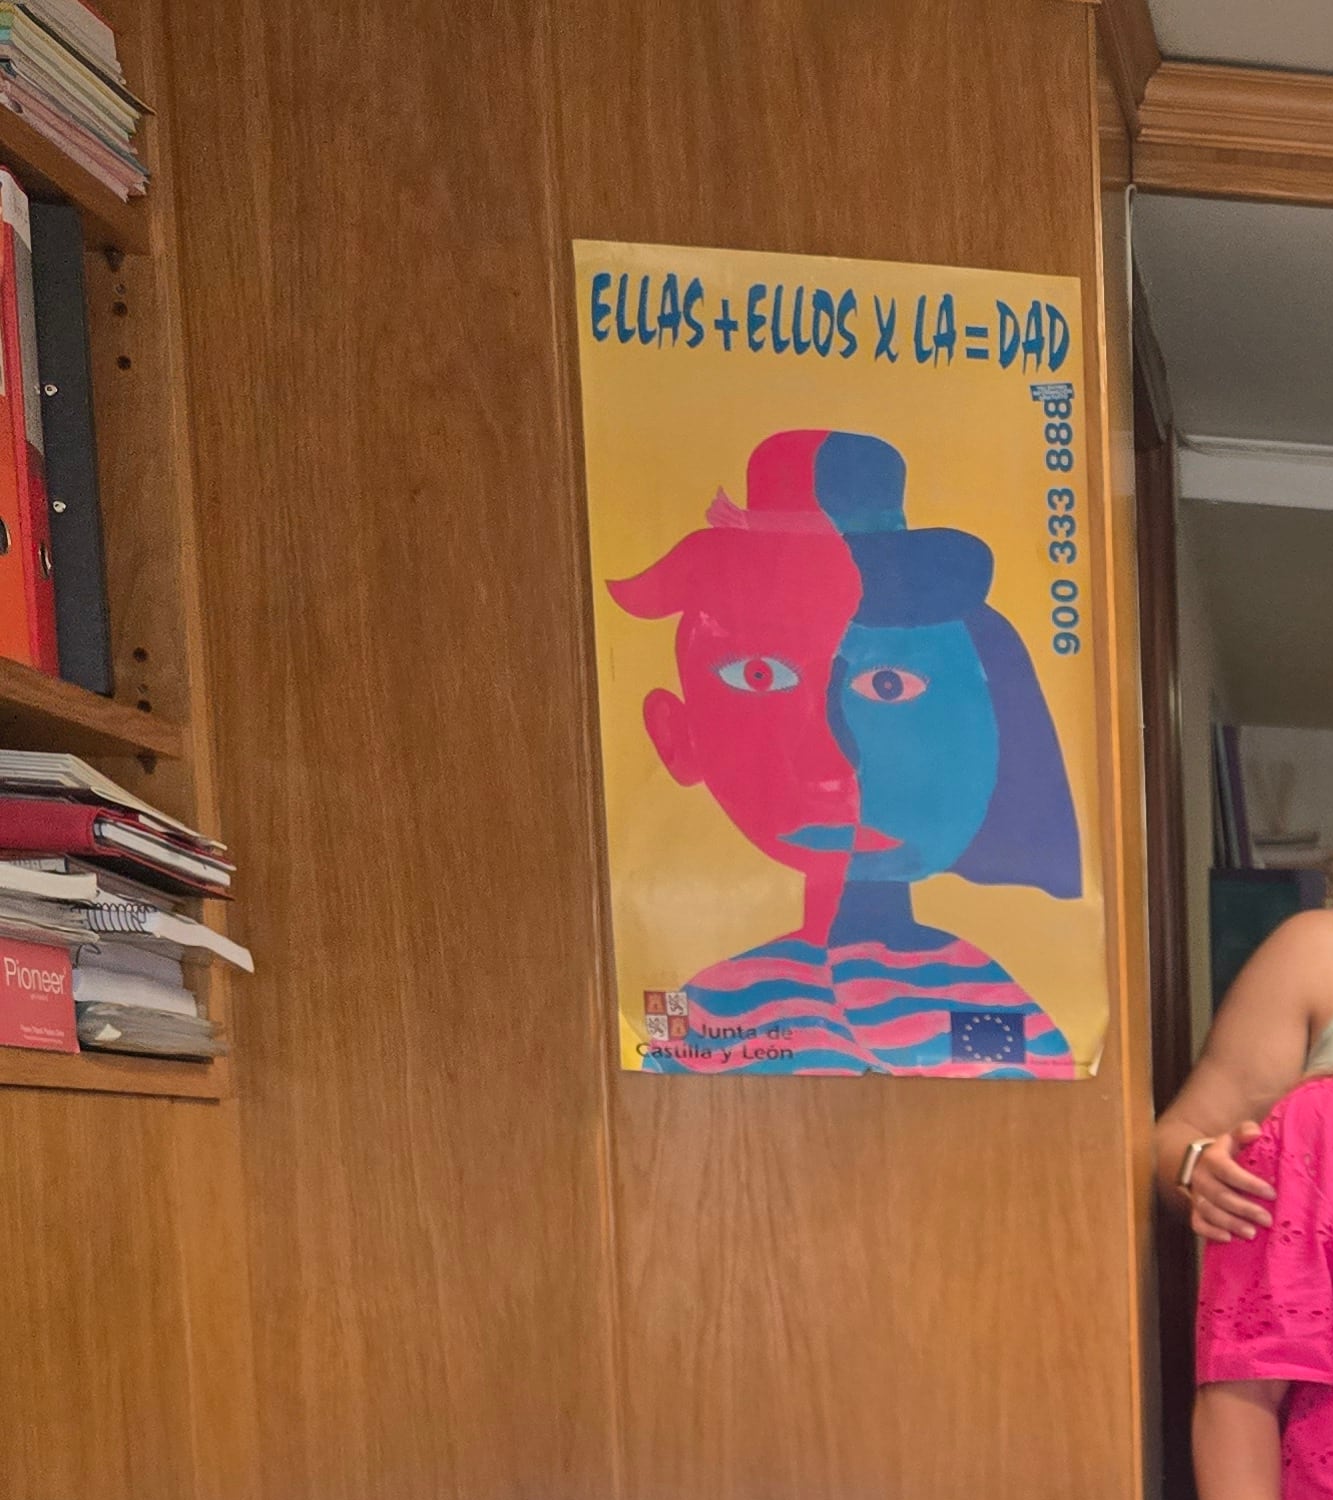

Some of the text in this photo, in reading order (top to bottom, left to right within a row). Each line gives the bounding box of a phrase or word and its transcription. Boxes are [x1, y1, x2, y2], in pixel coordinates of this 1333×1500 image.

[873, 294, 899, 364] X
[1044, 398, 1074, 473] 888
[1047, 487, 1077, 564] 333
[1051, 579, 1081, 656] 900
[4, 957, 65, 994] Pioneer
[636, 1042, 794, 1063] Castilla y León
[700, 1024, 793, 1040] Junta de
